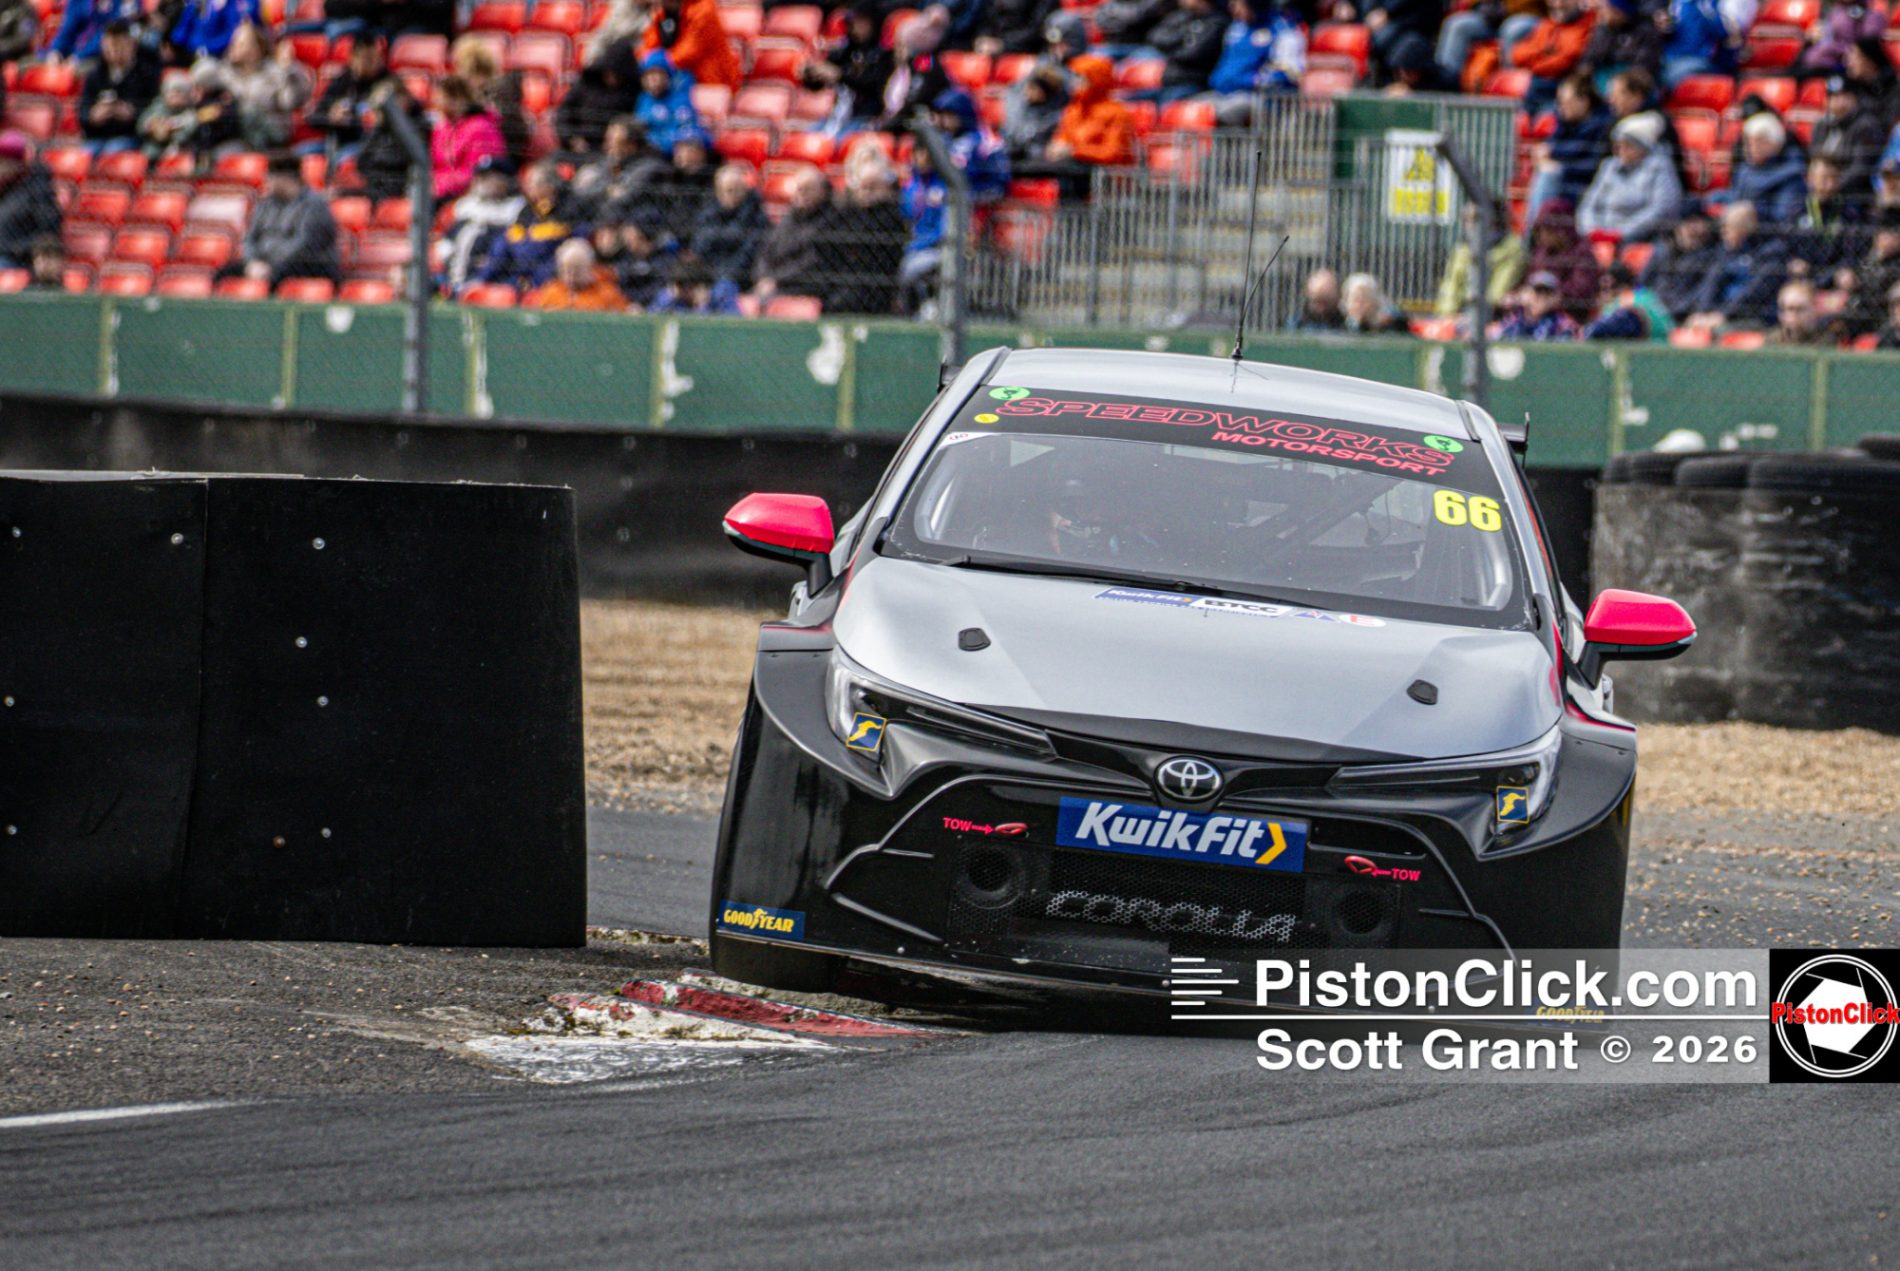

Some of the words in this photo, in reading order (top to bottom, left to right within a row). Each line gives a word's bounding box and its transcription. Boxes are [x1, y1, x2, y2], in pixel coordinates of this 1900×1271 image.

[995, 397, 1456, 467] SPEEDWORKS
[1211, 431, 1448, 477] MOTORSPORT
[1433, 489, 1502, 532] 66
[1204, 599, 1279, 614] BTCC
[943, 817, 973, 832] TOW
[1391, 868, 1421, 881] TOW
[723, 908, 795, 933] GOODYEAR
[1045, 890, 1296, 942] COROLLA
